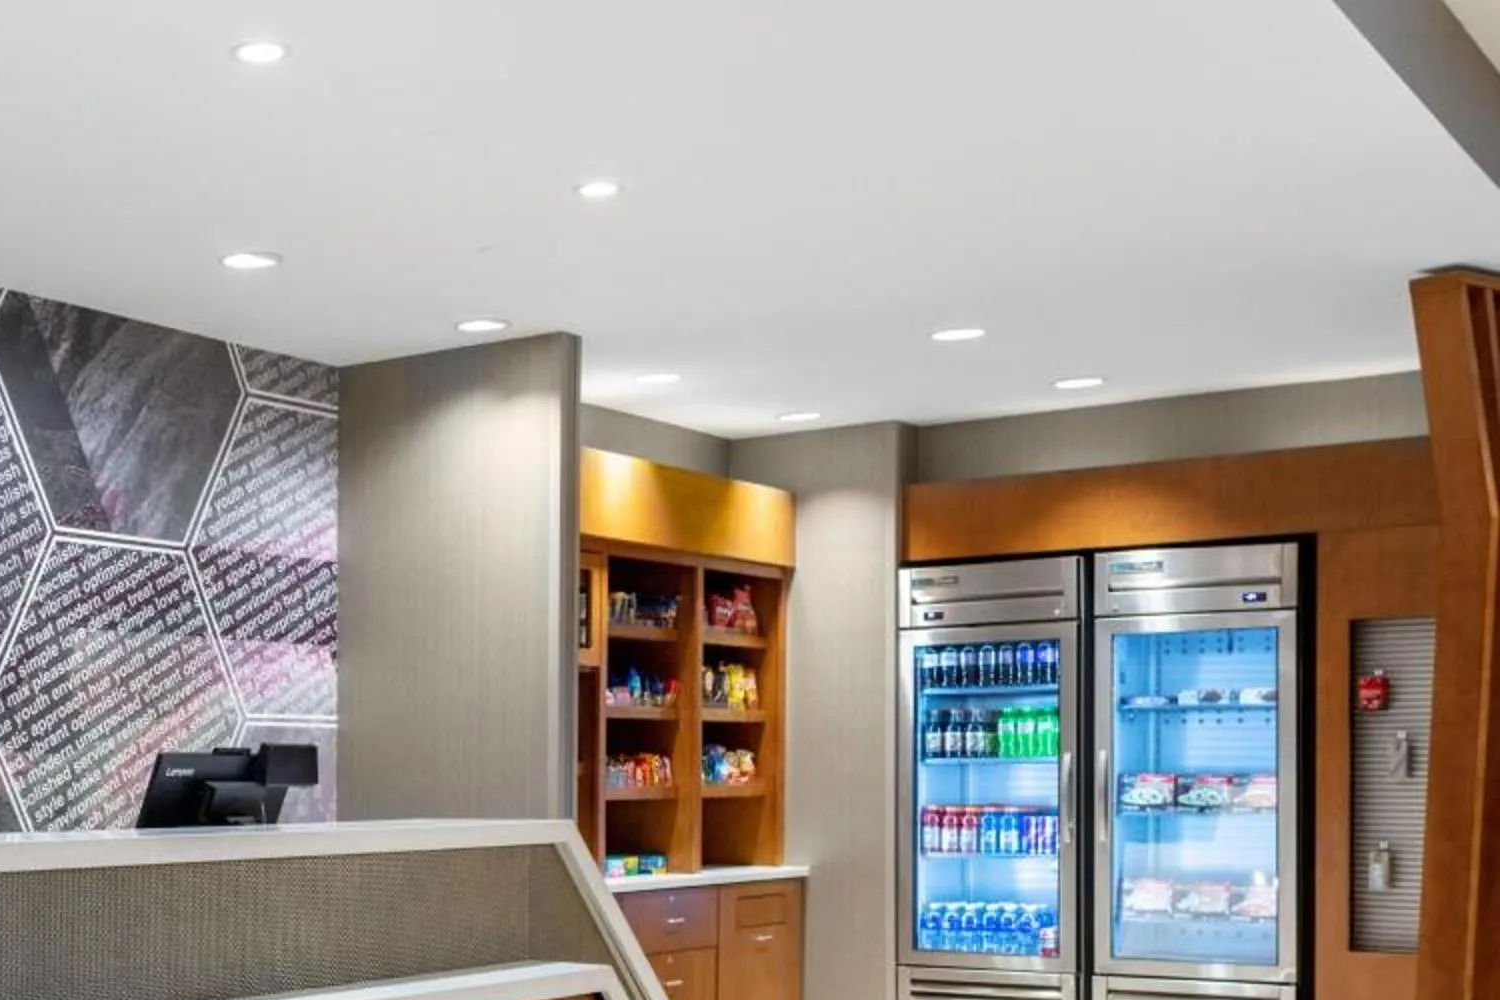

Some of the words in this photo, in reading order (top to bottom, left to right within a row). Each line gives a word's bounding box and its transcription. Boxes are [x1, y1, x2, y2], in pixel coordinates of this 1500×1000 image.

[25, 623, 55, 651] treat
[56, 596, 101, 632] modern
[102, 555, 169, 600] unexpected
[39, 586, 81, 619] vibrant
[81, 551, 139, 593] optimistic
[214, 582, 252, 614] human
[225, 558, 257, 587] space
[235, 568, 297, 620] environment
[235, 601, 283, 641] approach
[283, 589, 303, 609] hue
[6, 684, 31, 707] mix
[32, 651, 85, 695] pleasure
[85, 630, 117, 657] more
[117, 604, 155, 636] simple
[155, 588, 180, 611] love
[14, 694, 51, 729] youth
[52, 645, 125, 701] environment
[124, 619, 166, 652] human
[165, 599, 194, 625] style
[18, 644, 59, 678] simple
[60, 626, 87, 650] love
[87, 601, 128, 633] design
[128, 582, 155, 607] treat
[263, 606, 305, 642] surprise
[25, 723, 71, 762] vibrant
[71, 686, 128, 734] optimistic
[128, 649, 182, 695] approach
[181, 635, 203, 660] hue
[27, 743, 75, 783] modern
[75, 695, 142, 750] unexpected
[142, 668, 183, 703] vibrant
[30, 691, 88, 738] approach
[88, 675, 111, 696] hue
[111, 653, 146, 681] youth
[24, 763, 73, 808] polished
[73, 738, 116, 774] service
[116, 707, 158, 741] refresh
[34, 795, 66, 823] style
[66, 768, 101, 801] shake
[102, 742, 141, 775] space
